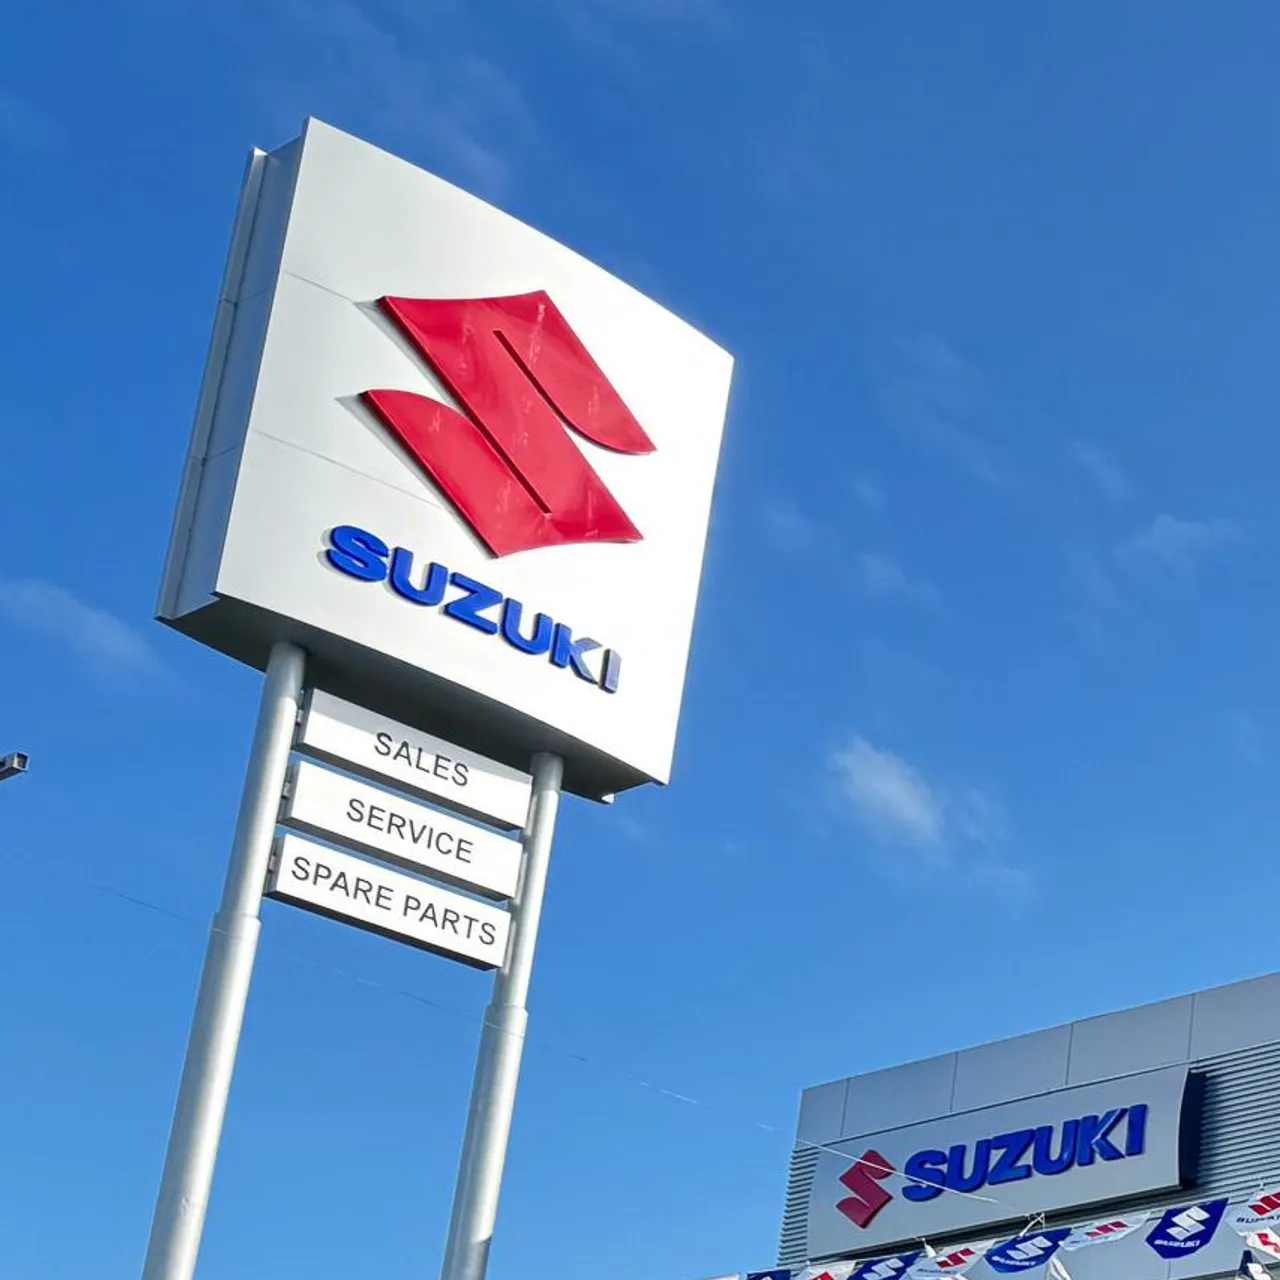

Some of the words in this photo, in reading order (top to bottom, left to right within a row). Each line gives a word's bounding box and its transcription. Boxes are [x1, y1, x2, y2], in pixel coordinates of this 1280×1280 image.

[325, 523, 623, 695] SUZUKI
[373, 731, 470, 788] SALES
[346, 798, 475, 864] SERVICE
[290, 856, 395, 912] SPARE
[402, 894, 497, 946] PARTS
[901, 1103, 1147, 1202] SUZUKI
[1153, 1238, 1201, 1248] SUZUKI
